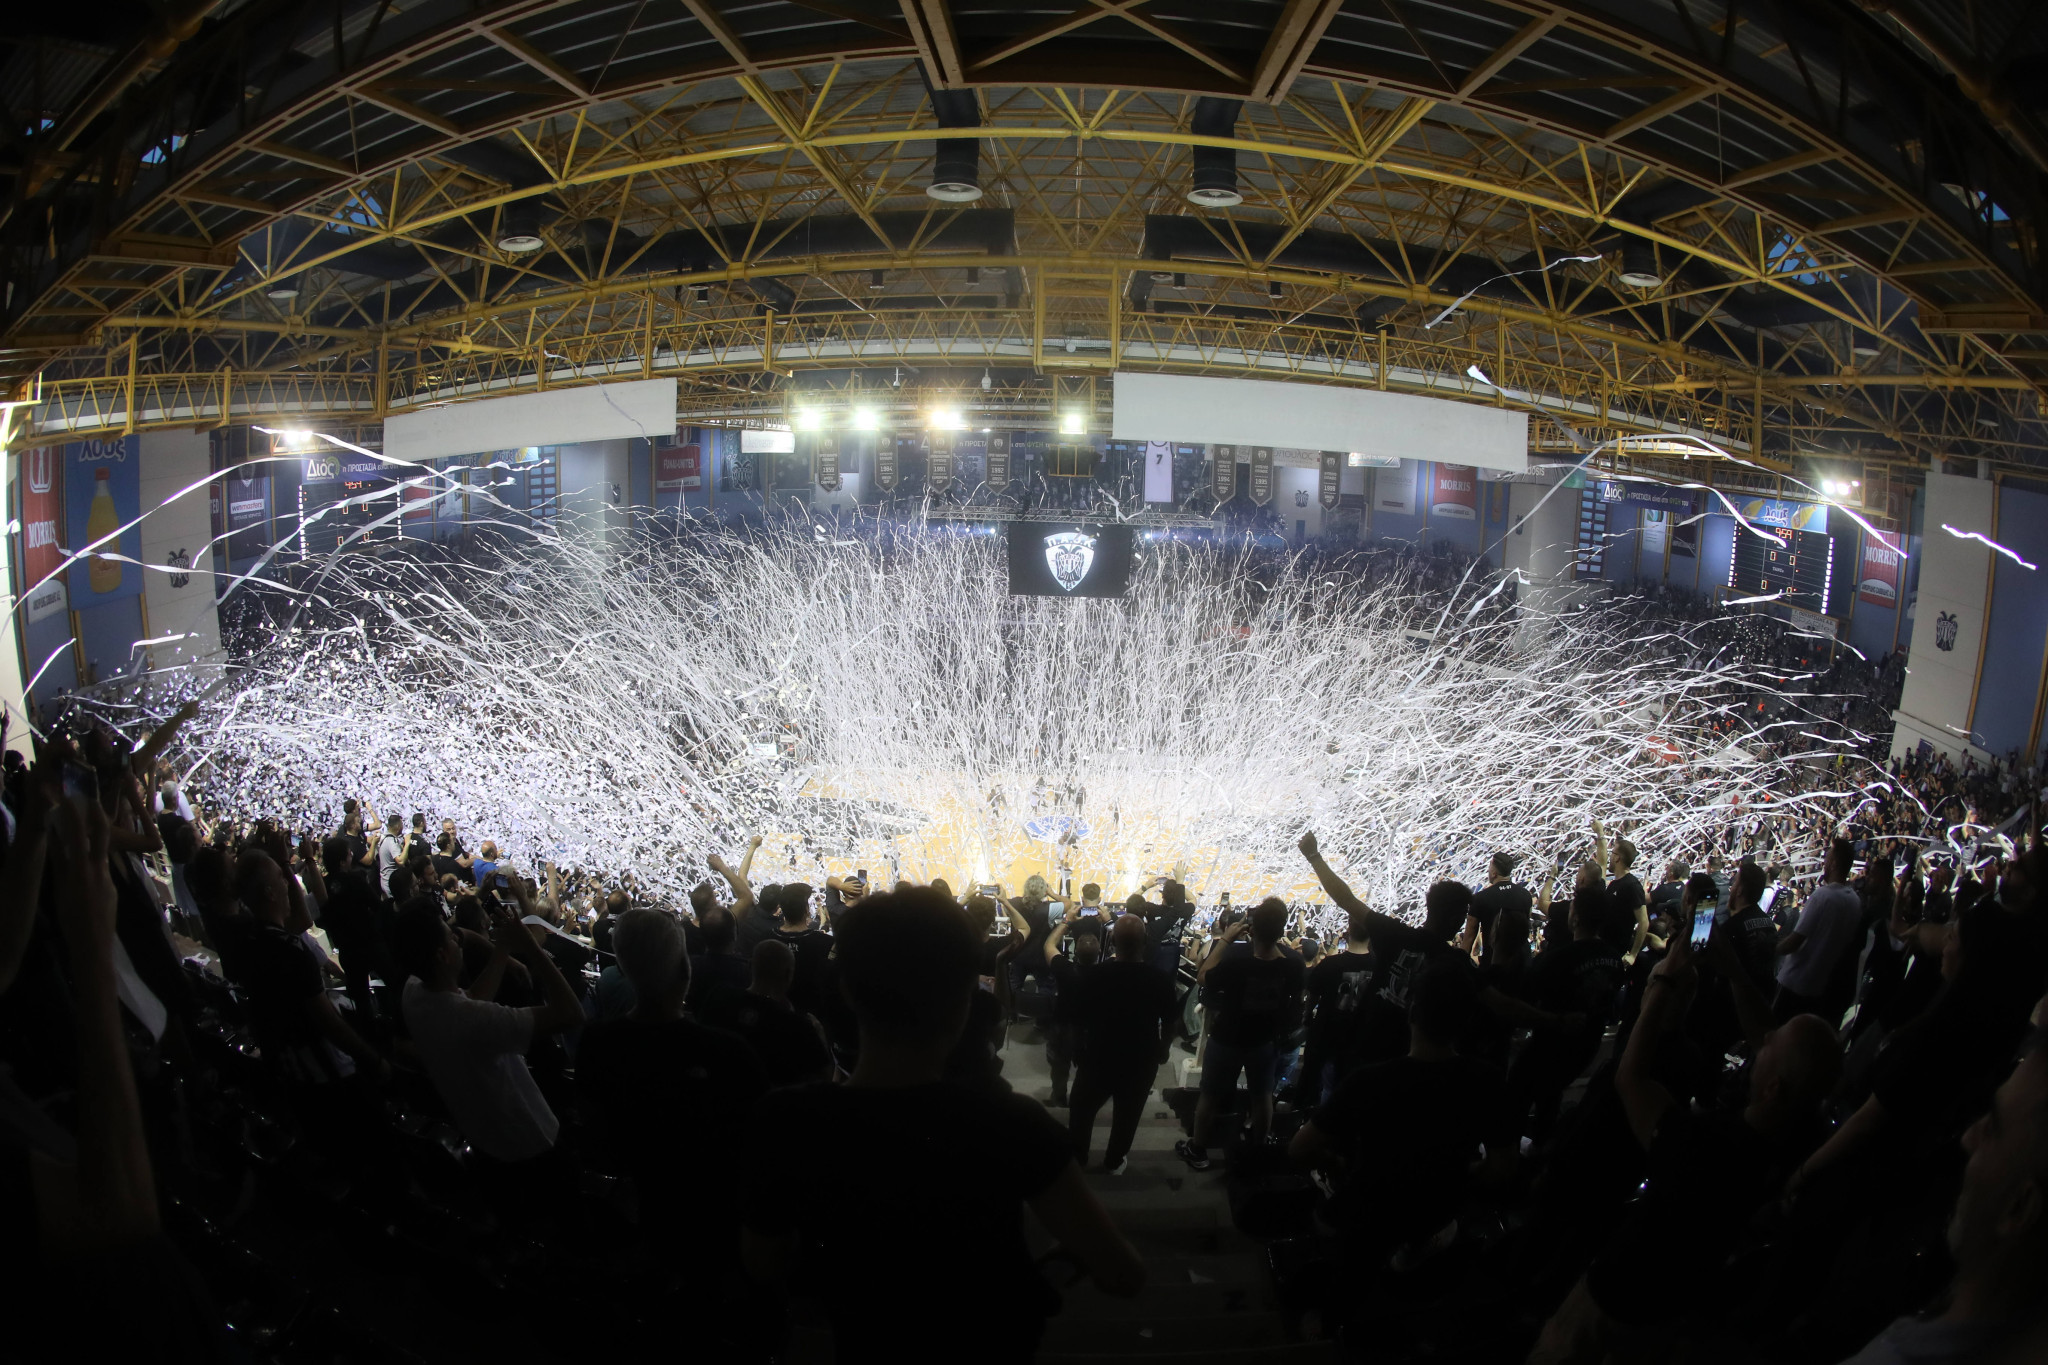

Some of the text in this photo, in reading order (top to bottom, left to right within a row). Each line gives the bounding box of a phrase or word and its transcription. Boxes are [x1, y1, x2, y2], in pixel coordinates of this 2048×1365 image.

[307, 459, 335, 479] Διός
[1156, 454, 1163, 465] 7
[1440, 479, 1471, 492] MORRIS
[1604, 483, 1623, 502] Διός
[28, 520, 56, 548] MORRIS
[1865, 546, 1899, 567] MORRIS
